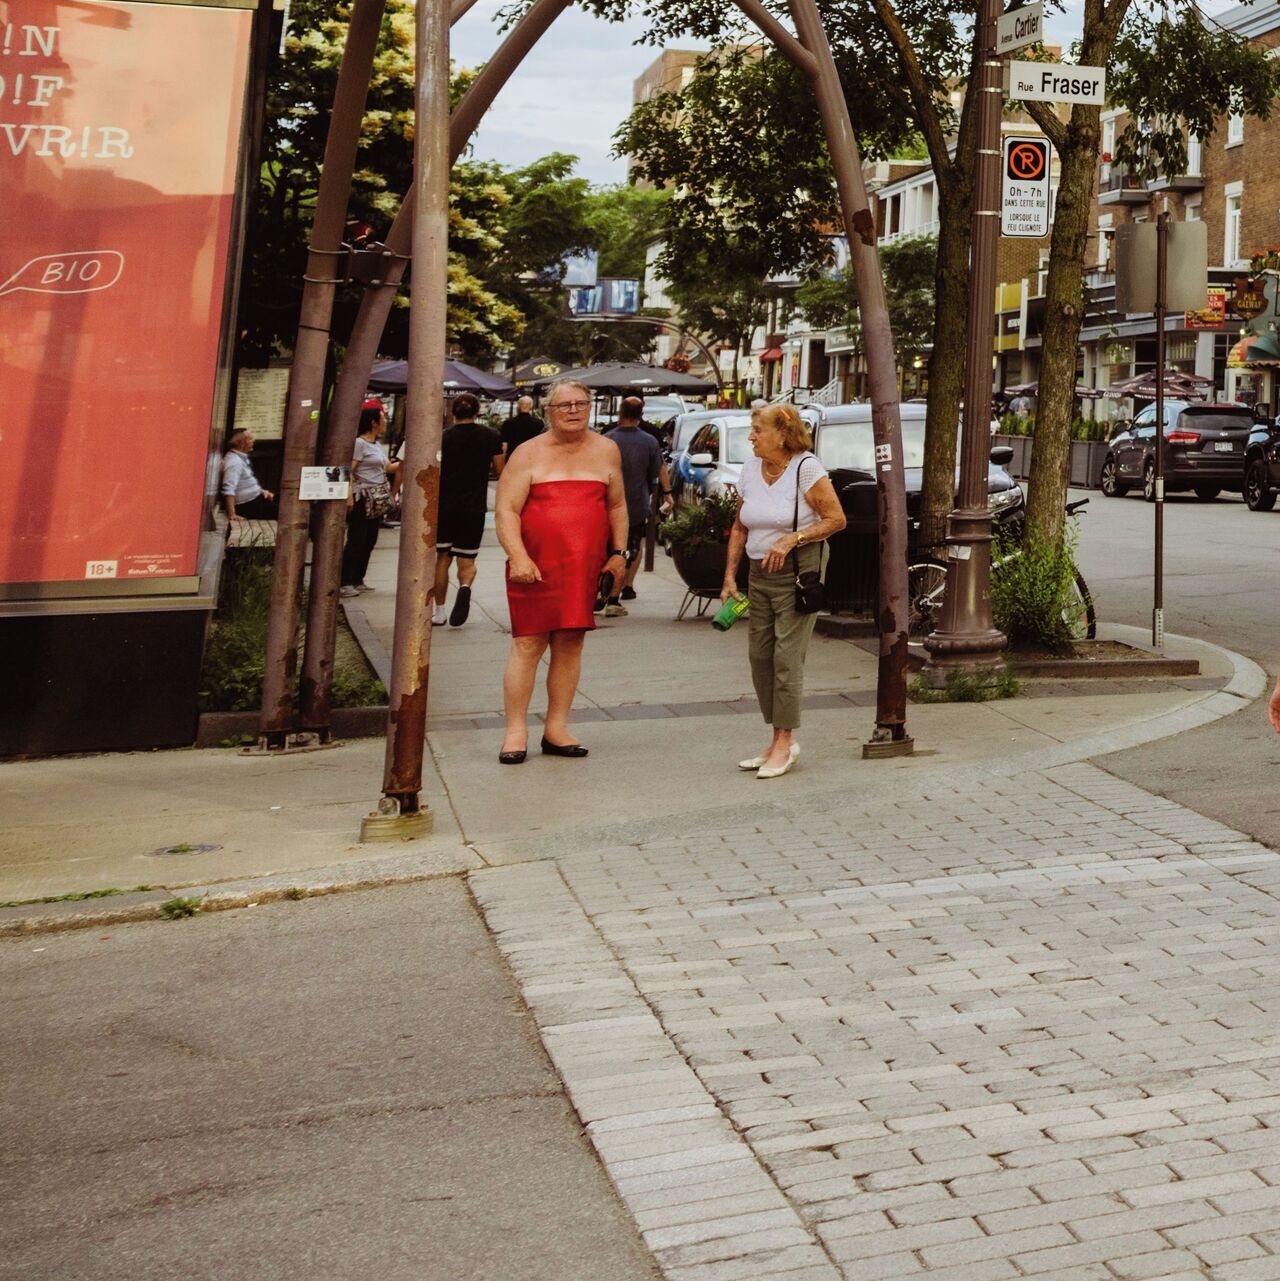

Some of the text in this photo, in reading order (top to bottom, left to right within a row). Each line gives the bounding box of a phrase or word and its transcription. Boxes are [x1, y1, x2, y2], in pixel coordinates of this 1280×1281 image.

[1015, 13, 1039, 39] Cartier
[1018, 72, 1099, 96] Rue Fraser
[1036, 200, 1046, 208] RUE
[1009, 213, 1040, 222] LORSQUE LE
[1007, 223, 1042, 232] FEU CLIGNOTE
[41, 260, 101, 284] BIO
[90, 564, 115, 576] 18+
